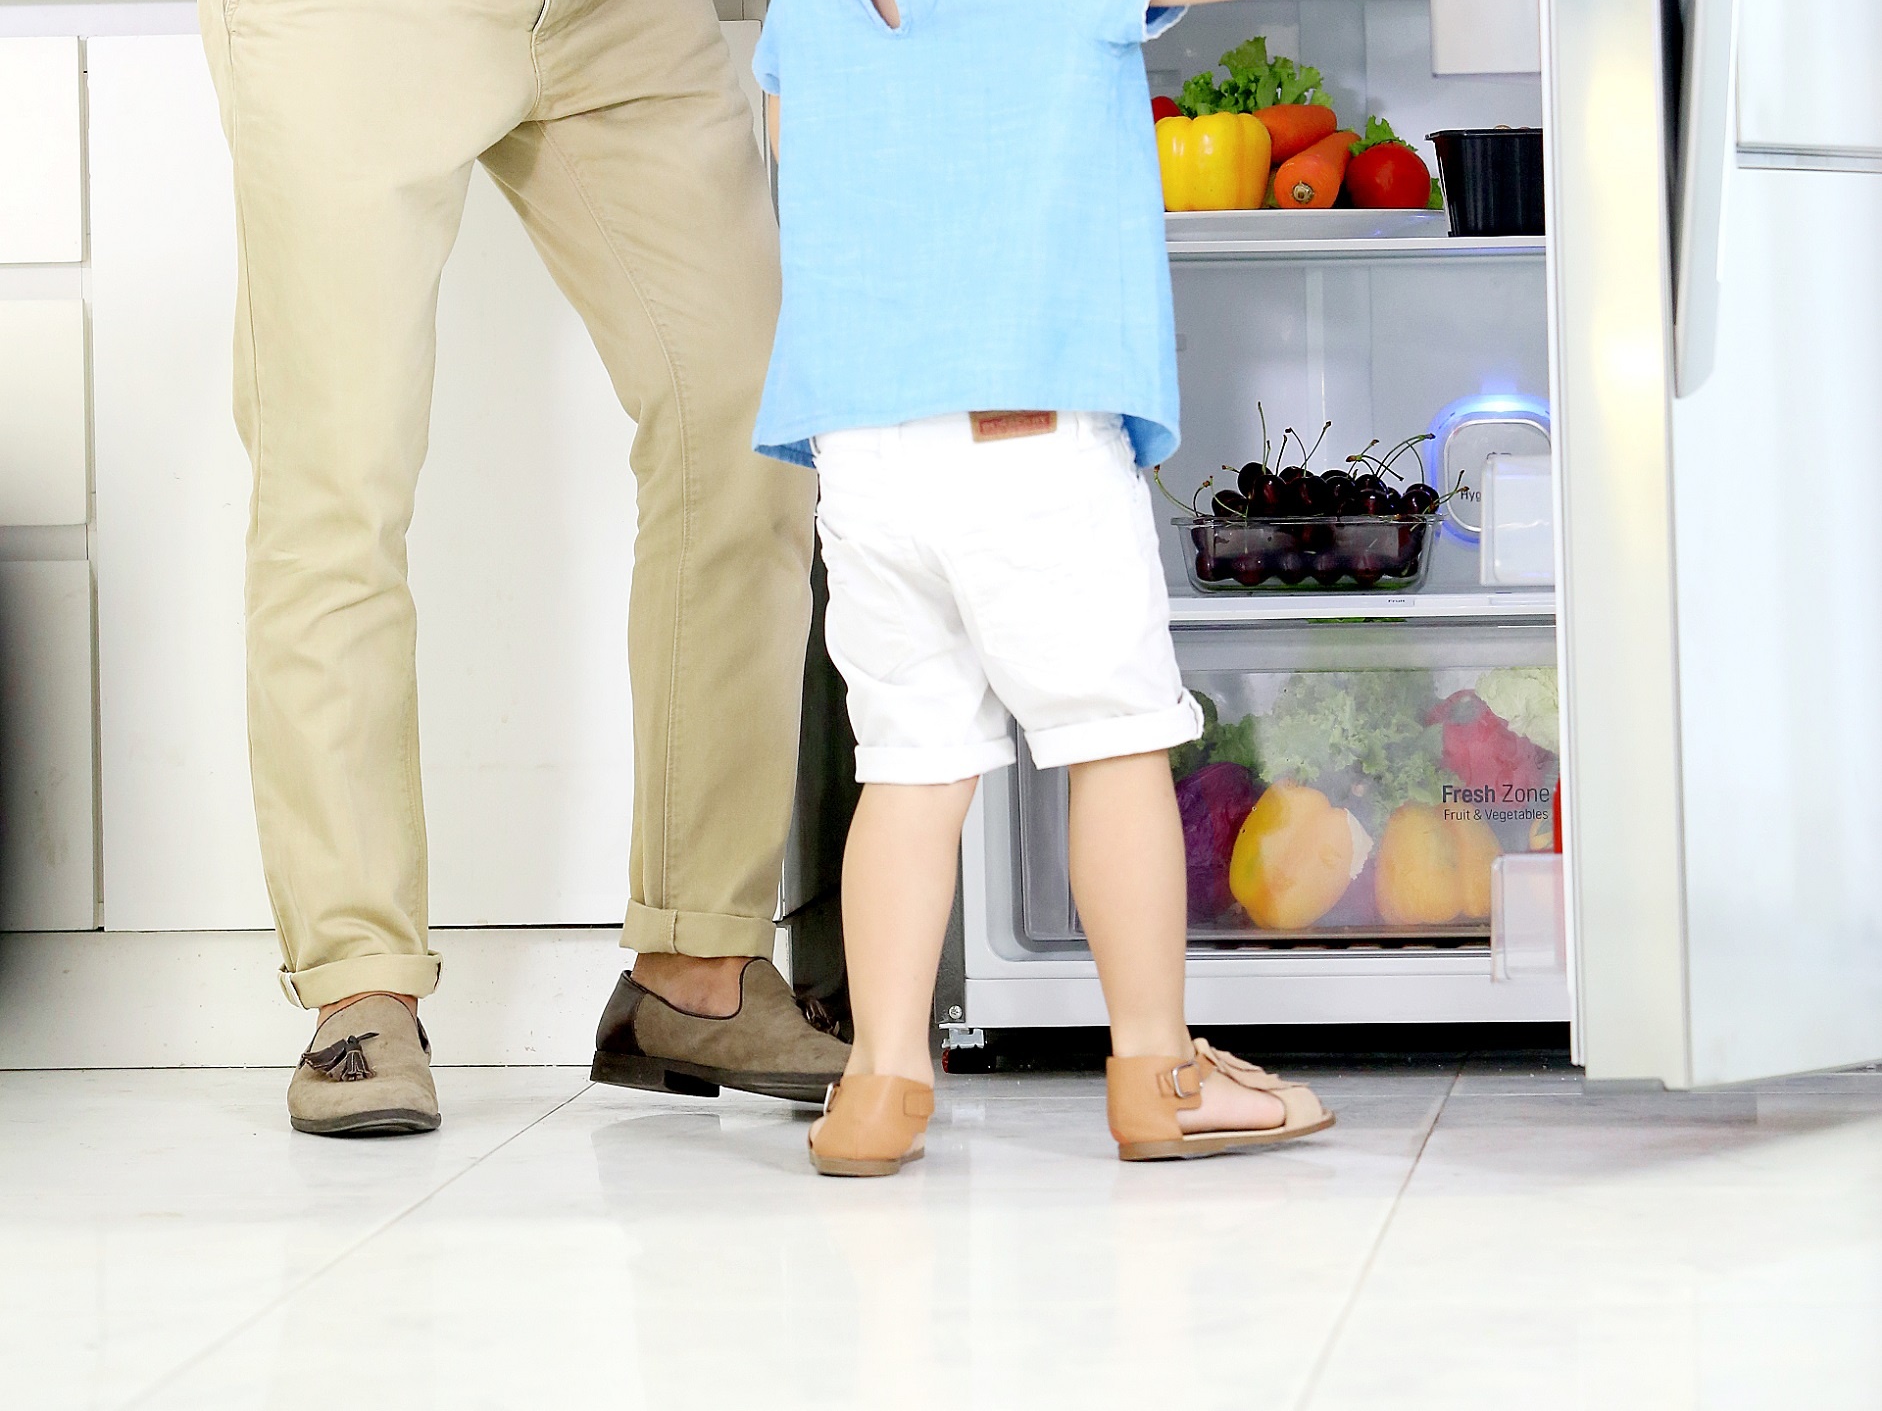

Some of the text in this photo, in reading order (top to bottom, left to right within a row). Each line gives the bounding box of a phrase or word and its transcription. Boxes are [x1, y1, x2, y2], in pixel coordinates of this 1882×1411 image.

[1442, 784, 1550, 804] Fresh Zone
[1444, 808, 1549, 823] Fruit & Vegetables
